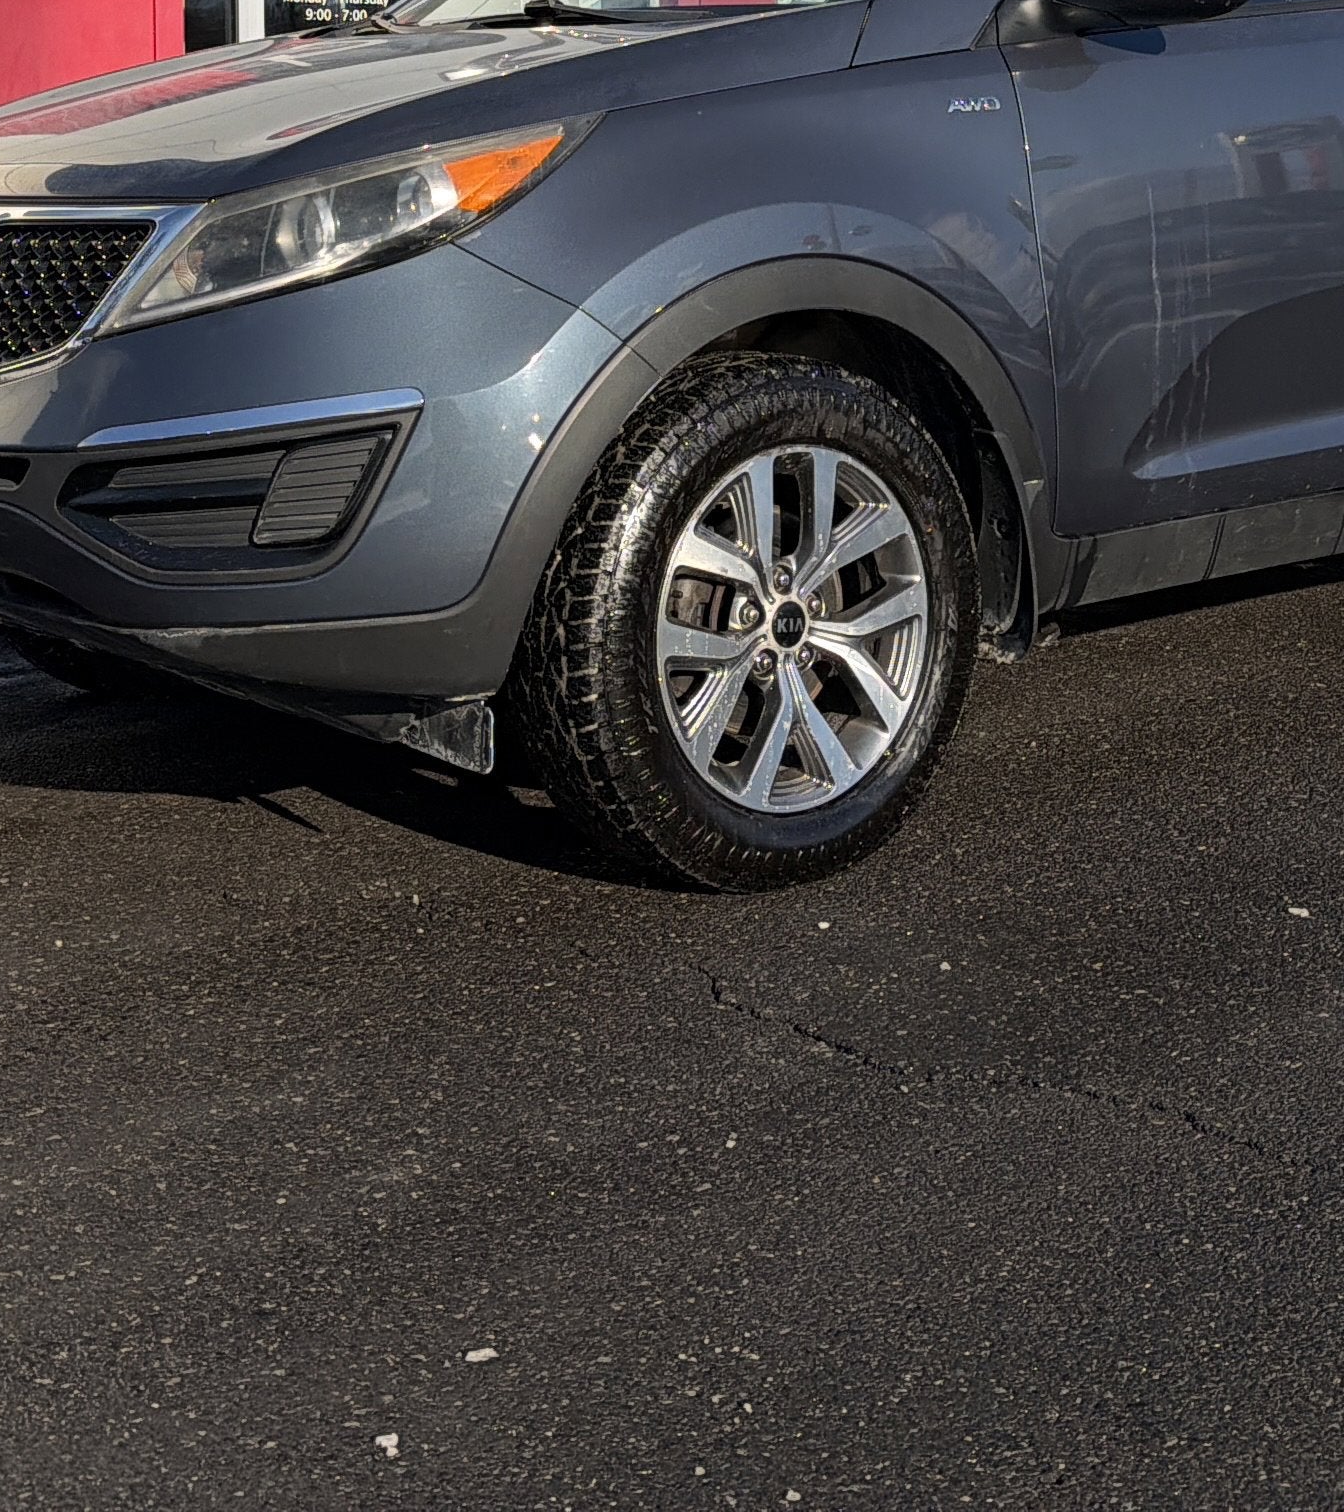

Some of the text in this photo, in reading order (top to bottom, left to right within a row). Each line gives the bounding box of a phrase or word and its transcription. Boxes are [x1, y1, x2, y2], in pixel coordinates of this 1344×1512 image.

[305, 8, 332, 22] 9:00
[341, 9, 368, 22] 7:00
[947, 96, 1001, 113] AWD
[777, 617, 804, 633] KIA
